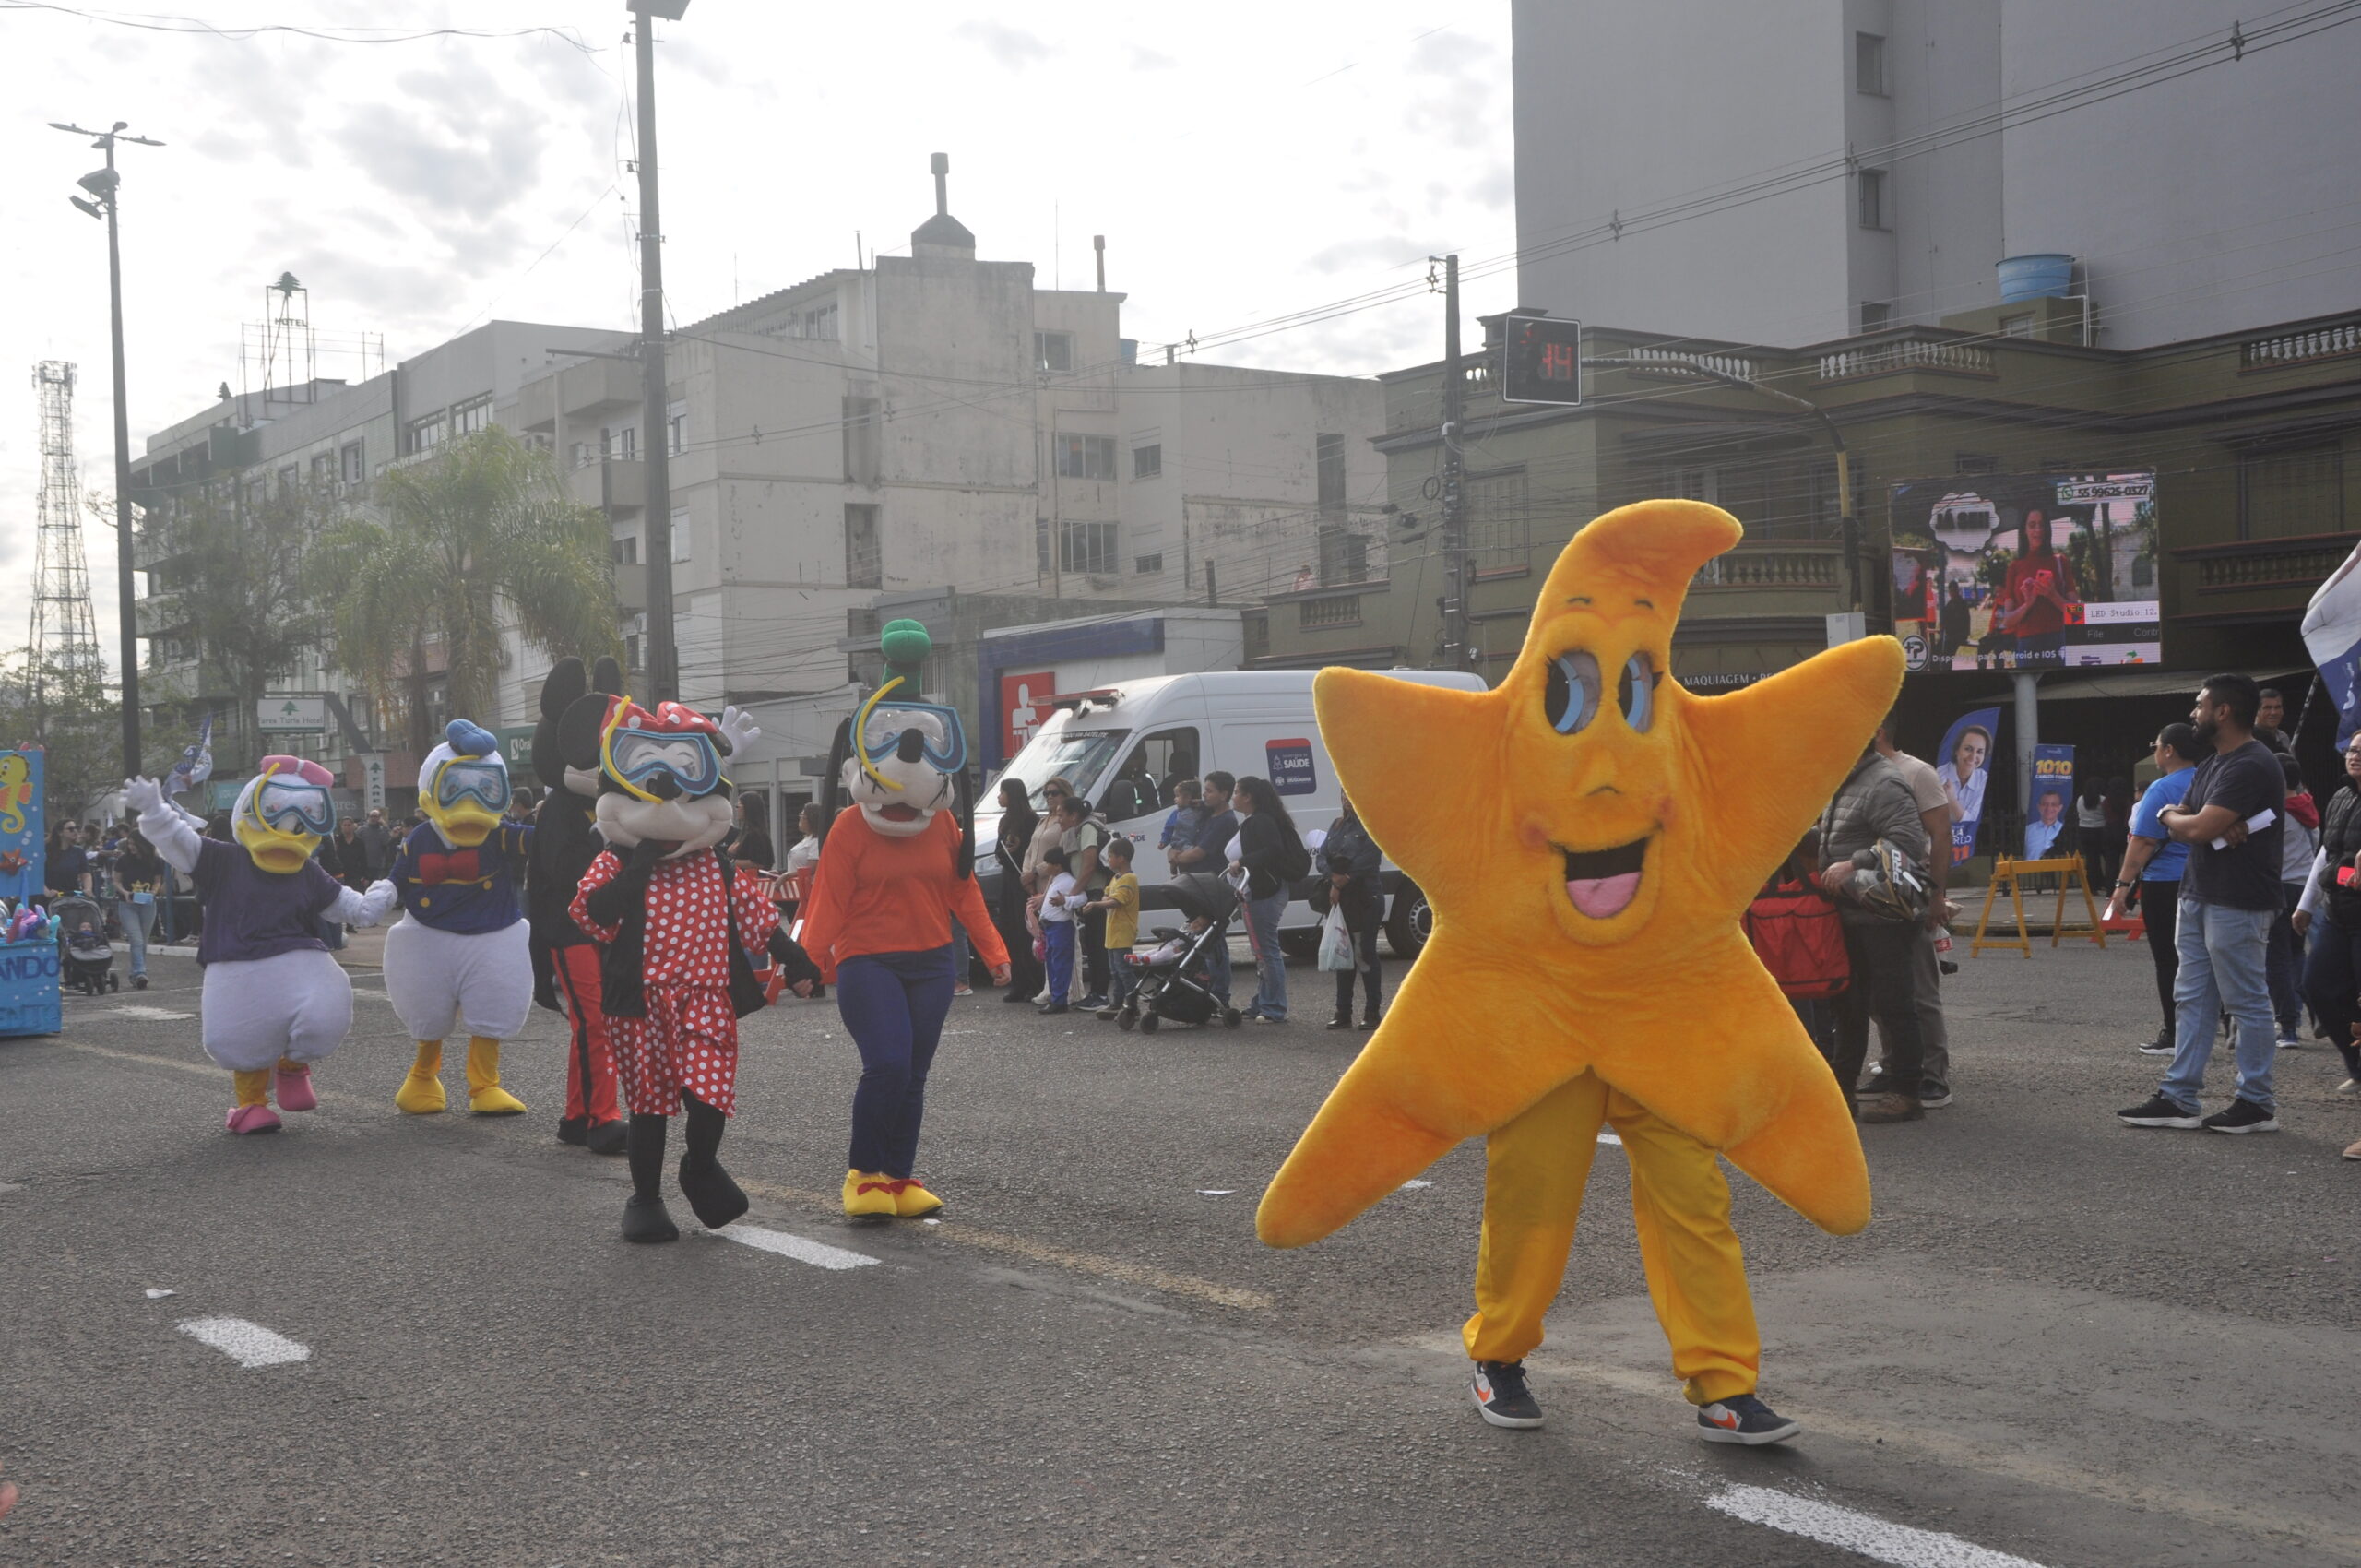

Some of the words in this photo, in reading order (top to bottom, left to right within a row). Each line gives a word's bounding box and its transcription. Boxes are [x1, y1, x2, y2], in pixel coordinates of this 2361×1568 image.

[2078, 488, 2090, 497] 55
[2091, 610, 2106, 618] LED
[2110, 609, 2140, 617] Studio
[2087, 629, 2104, 638] File
[1978, 651, 1997, 661] para
[1999, 649, 2032, 659] Android
[1683, 673, 1750, 686] MAQUIAGEM
[1283, 756, 1310, 769] SAÚDE
[2036, 759, 2073, 775] 1010
[1892, 849, 1904, 885] PRO
